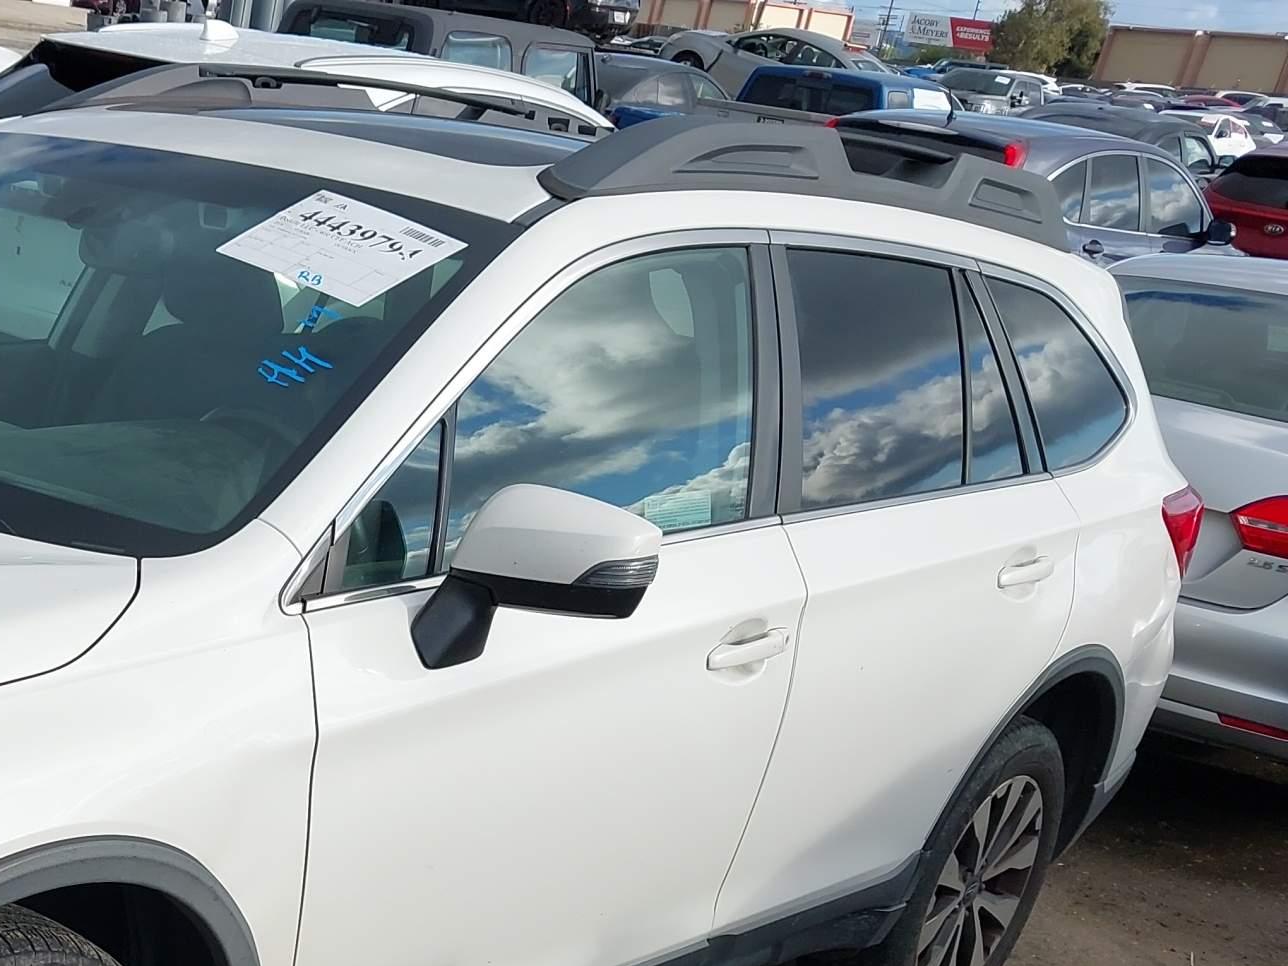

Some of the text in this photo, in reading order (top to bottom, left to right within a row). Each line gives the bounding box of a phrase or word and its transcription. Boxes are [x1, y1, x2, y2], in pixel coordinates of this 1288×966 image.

[911, 15, 940, 27] JACOBY
[299, 210, 423, 260] 44439794
[297, 270, 323, 286] RB
